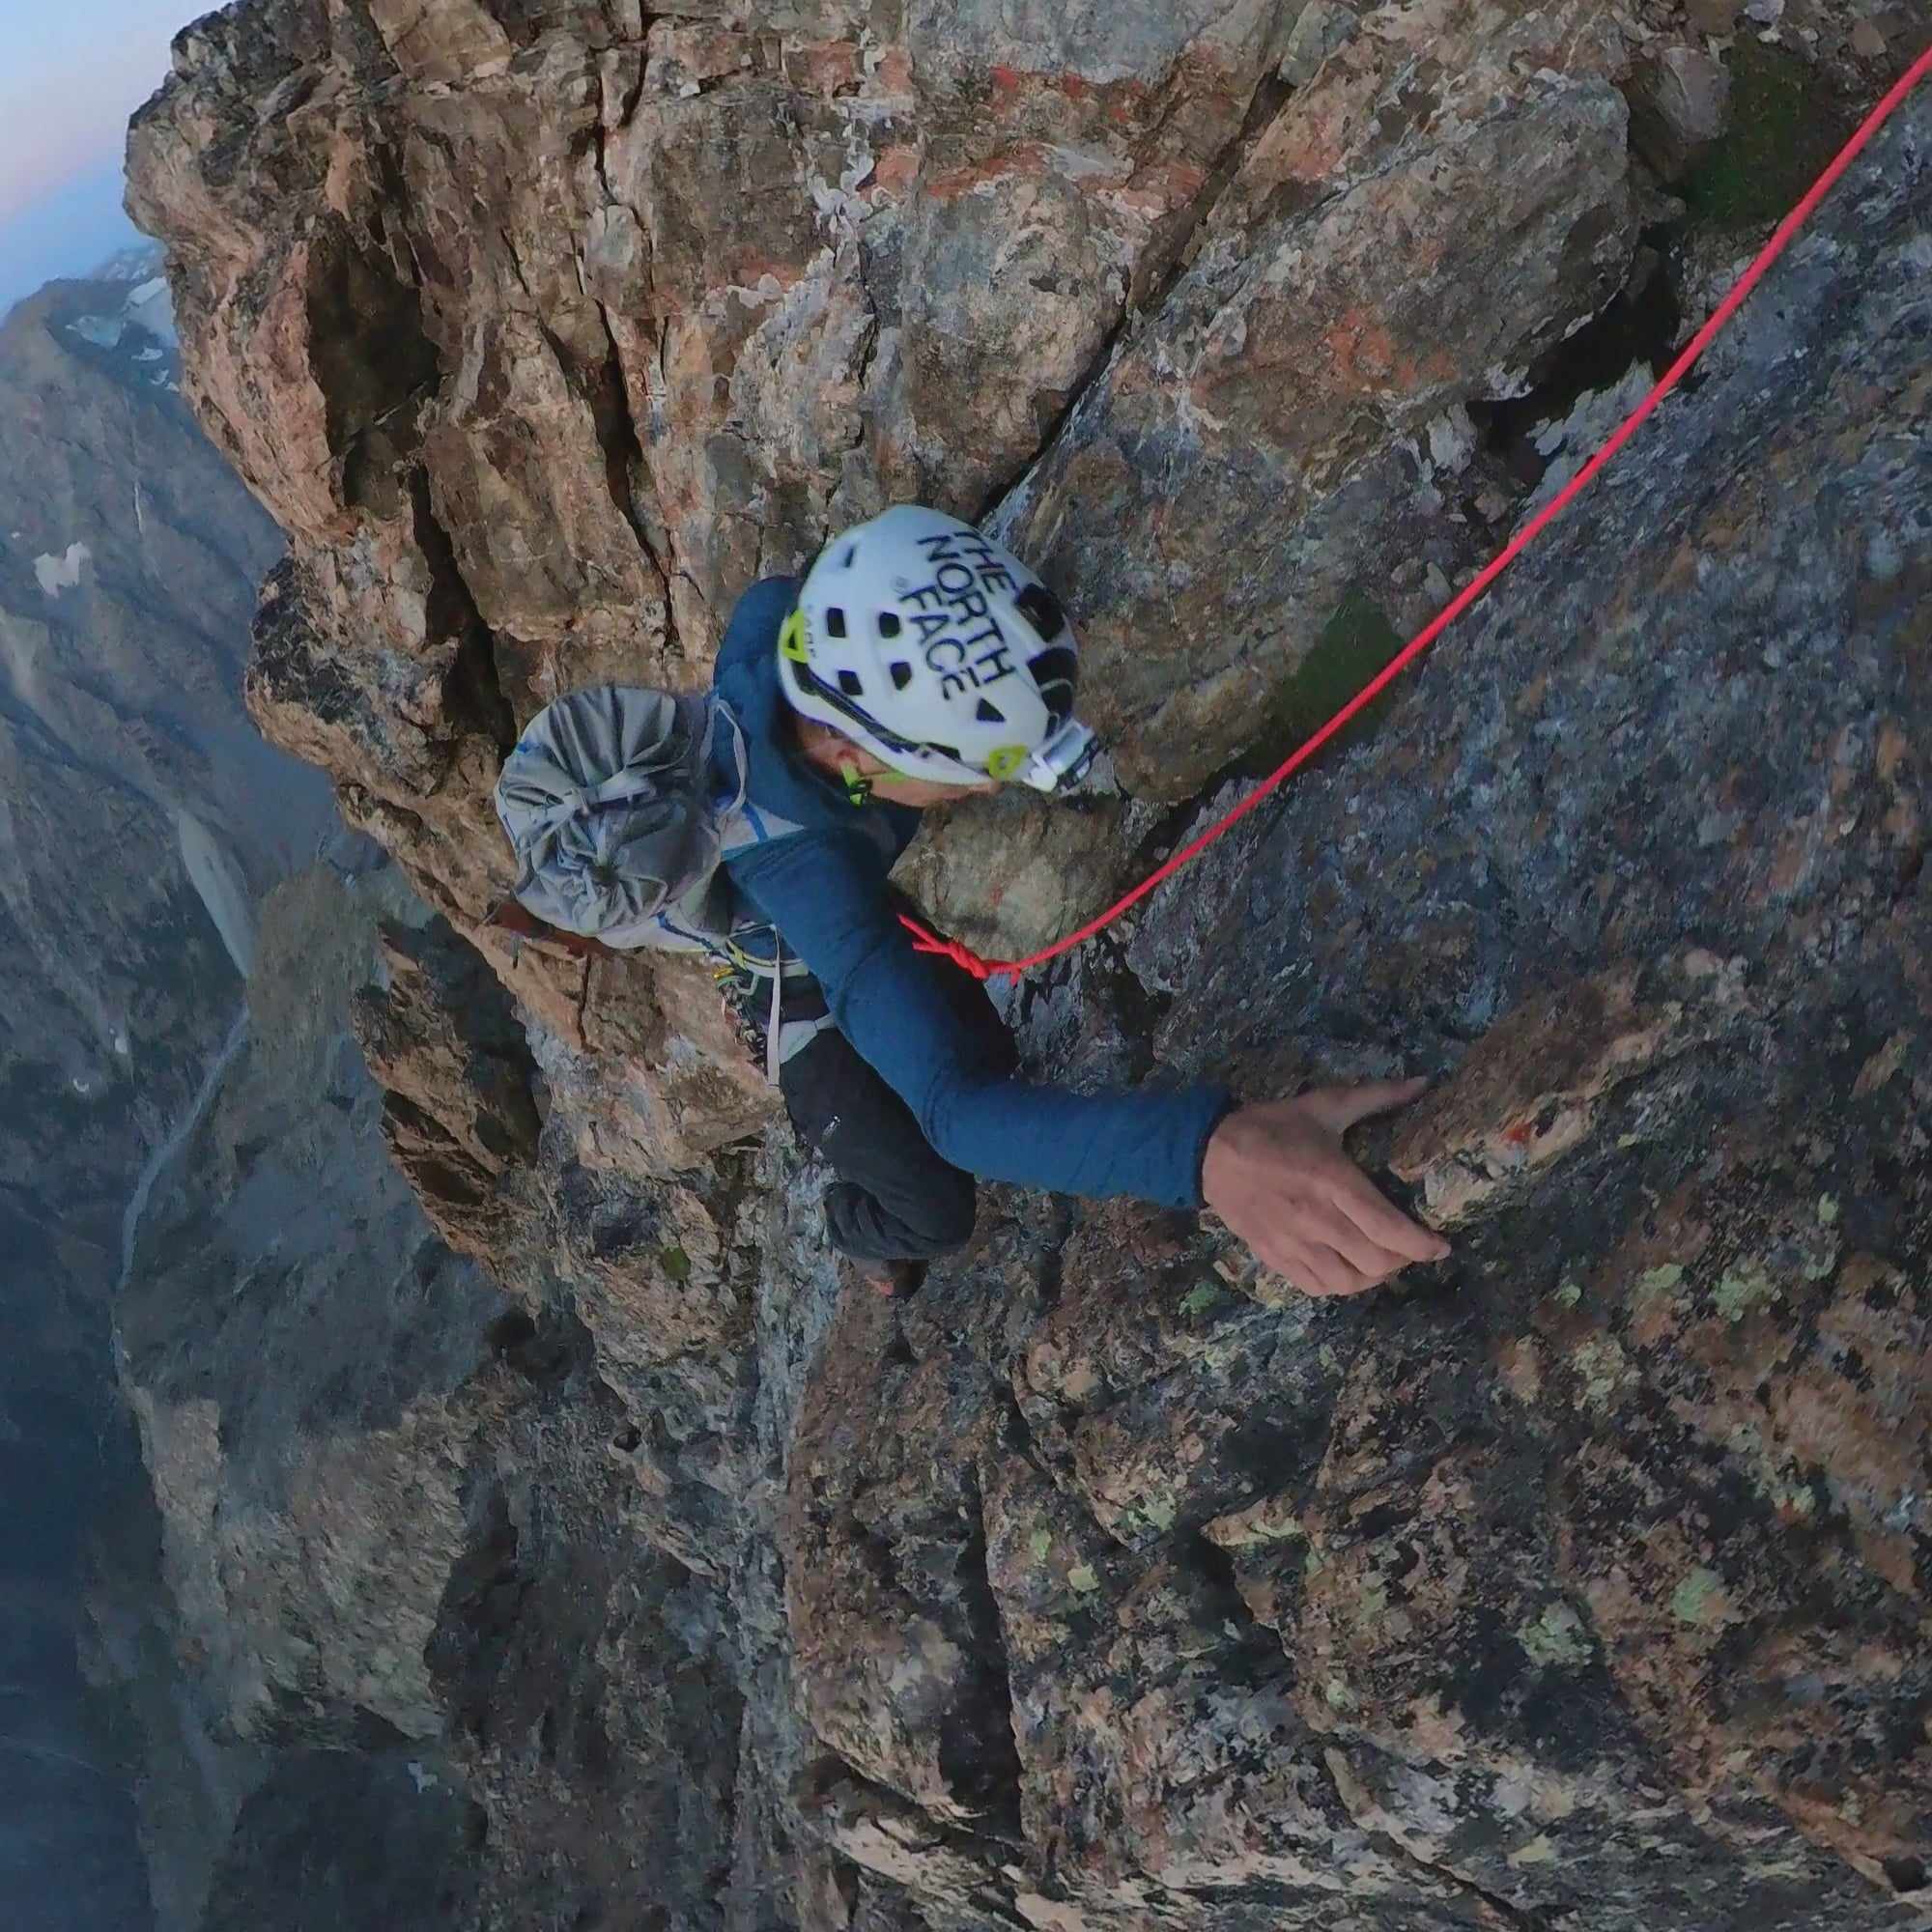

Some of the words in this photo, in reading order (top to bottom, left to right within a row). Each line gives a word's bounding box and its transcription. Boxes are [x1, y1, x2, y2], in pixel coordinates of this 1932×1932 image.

[917, 535, 1016, 685] NORTH
[953, 531, 1018, 594] THE
[898, 585, 980, 701] FACE
